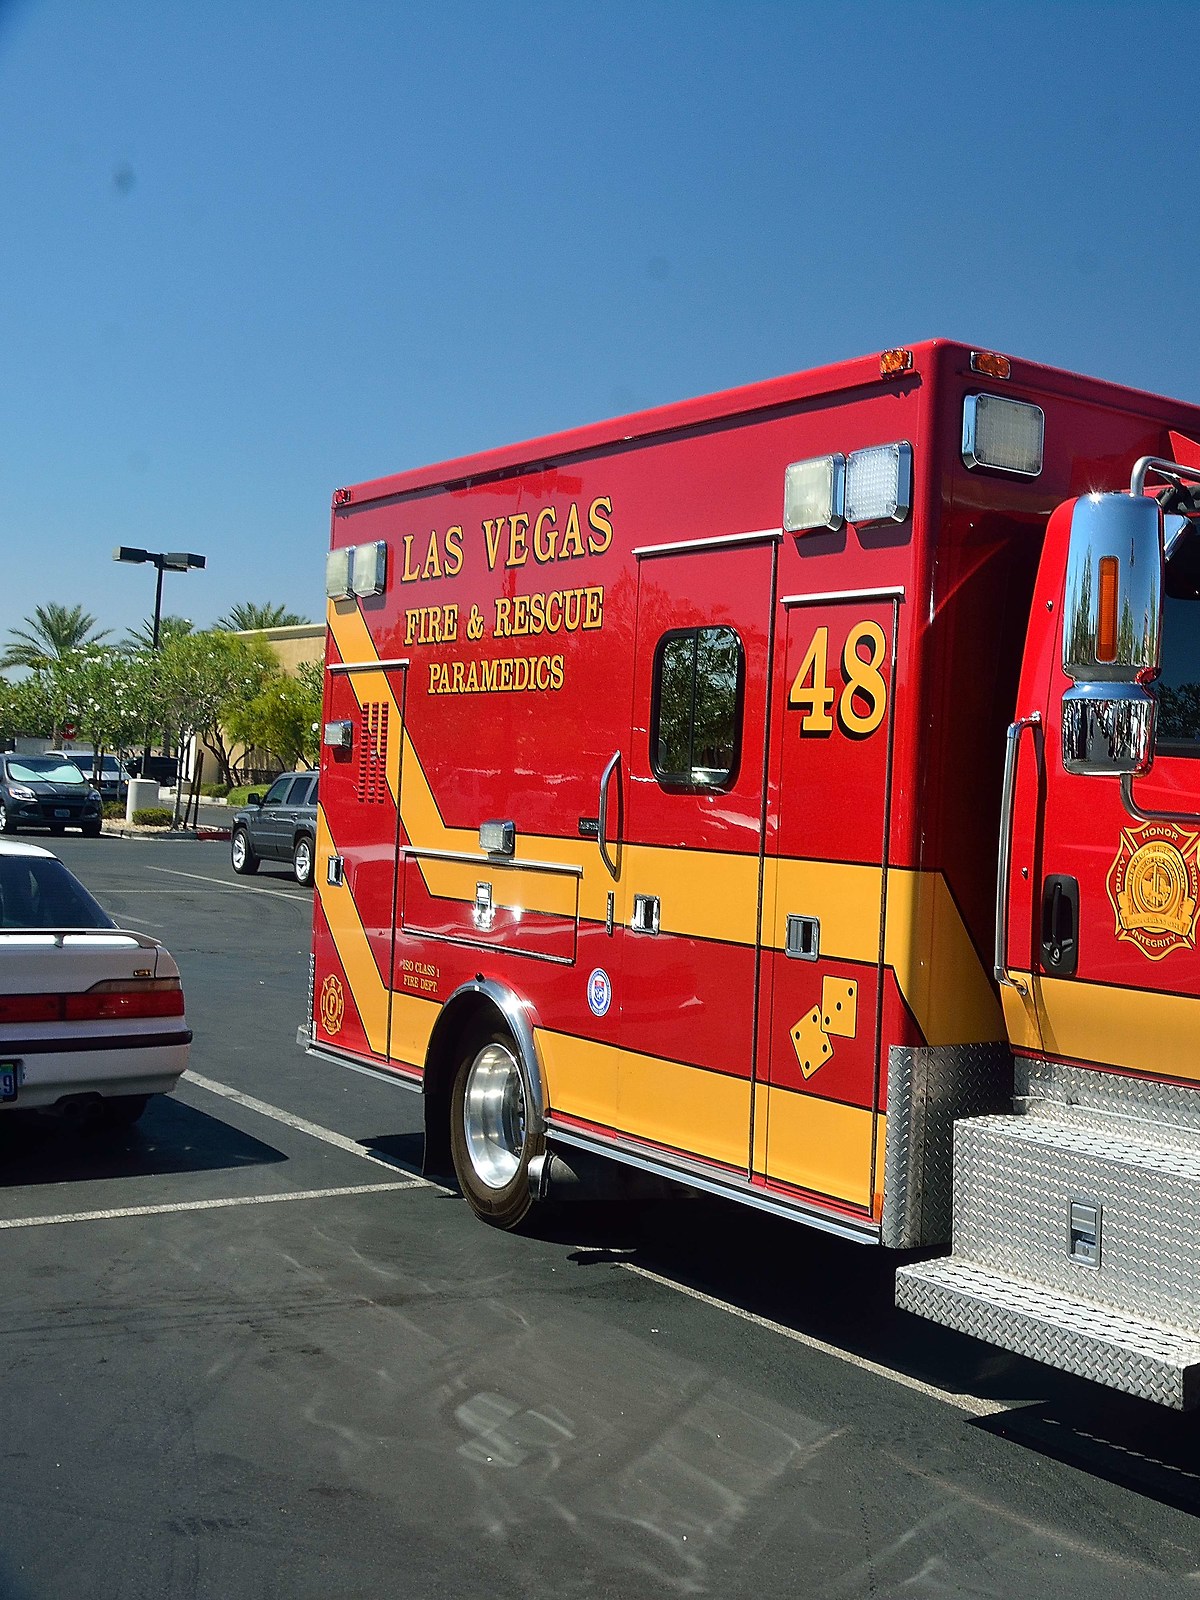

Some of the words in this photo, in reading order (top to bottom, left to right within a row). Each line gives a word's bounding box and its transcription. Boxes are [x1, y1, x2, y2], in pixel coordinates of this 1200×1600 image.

[401, 525, 464, 582] LAS
[482, 496, 613, 571] VEGAS
[404, 603, 458, 645] FIRE
[466, 604, 484, 640] &
[493, 586, 604, 637] RESCUE
[428, 655, 565, 694] PARAMEDICS
[788, 620, 887, 738] 48
[1141, 827, 1179, 841] HONOR
[1116, 856, 1126, 893] DUTY
[1188, 859, 1199, 901] TRUST
[1131, 929, 1176, 948] INTEGRITY
[402, 959, 414, 972] ISO
[415, 961, 435, 977] CLASS
[403, 974, 419, 988] FIRE
[420, 977, 439, 993] DEPT.
